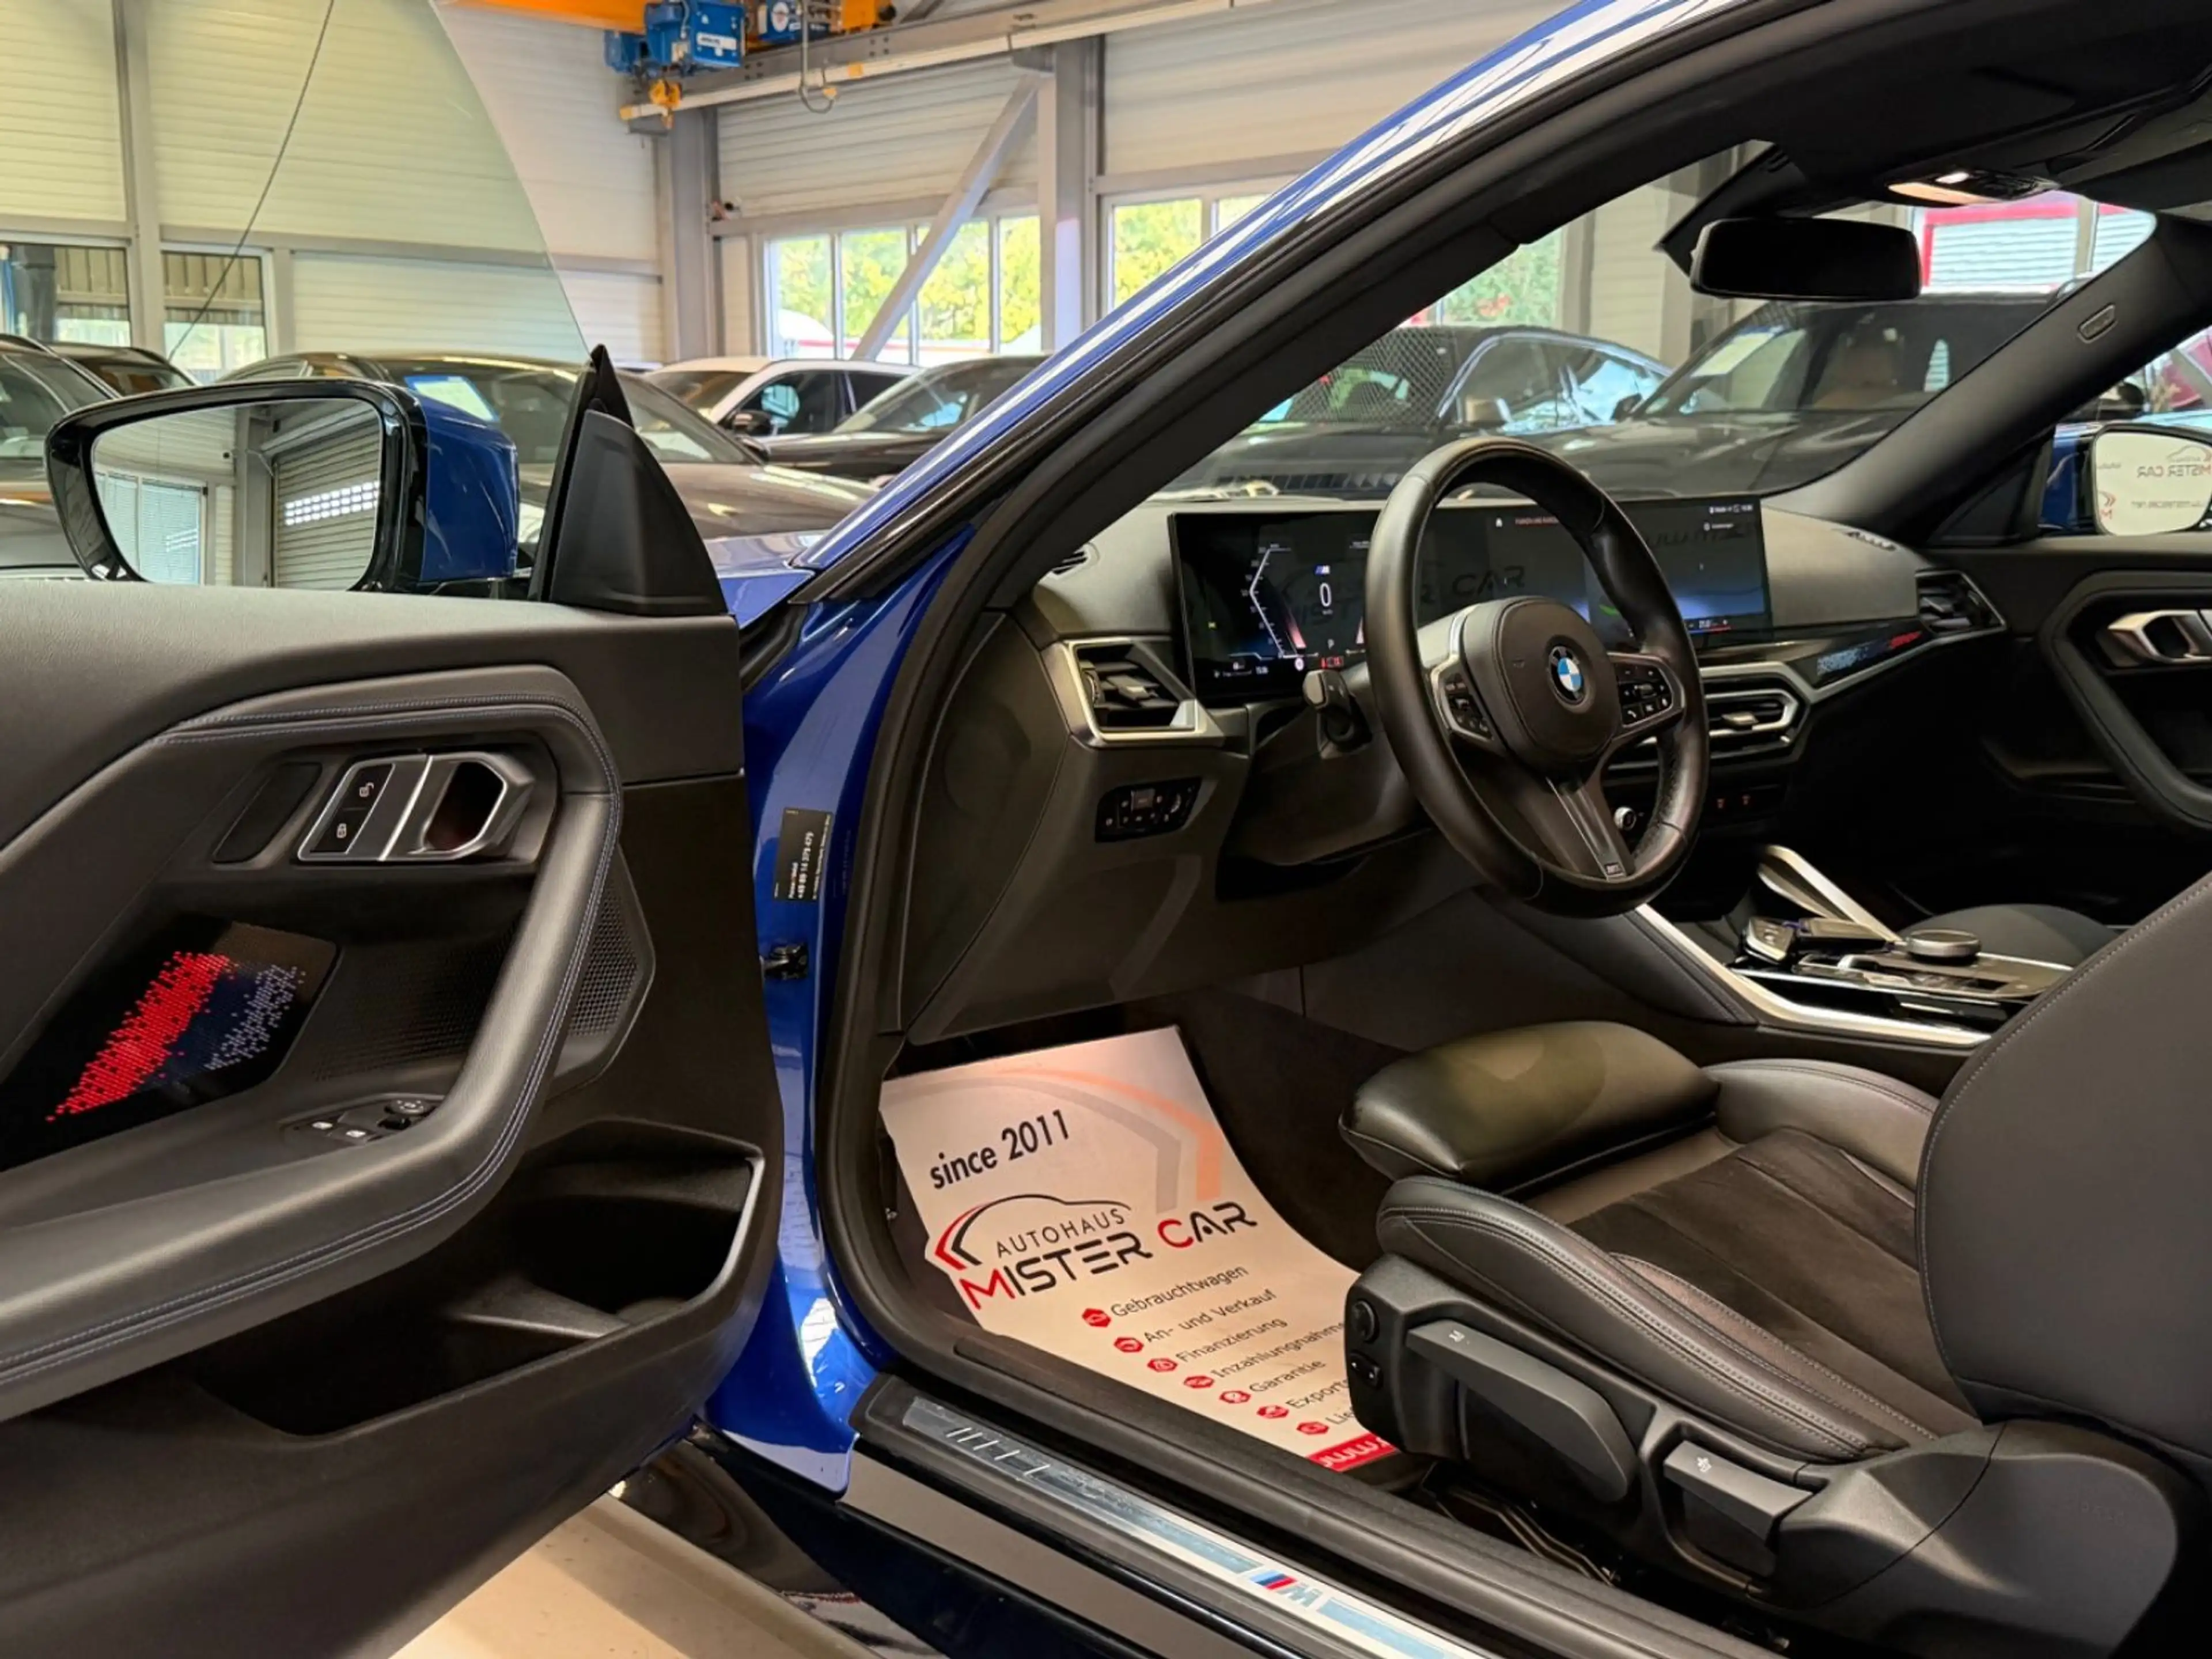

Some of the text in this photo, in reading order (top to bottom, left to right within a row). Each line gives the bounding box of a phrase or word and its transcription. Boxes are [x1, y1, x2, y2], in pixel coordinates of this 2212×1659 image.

[1319, 582, 1332, 607] 0
[930, 1109, 1069, 1190] since 2011
[959, 1201, 1258, 1310] MISTER CAR
[996, 1207, 1125, 1258] AUTOHAUS
[1111, 1266, 1250, 1317] Gebrauchtwagen
[1144, 1287, 1278, 1343] An- und Verkauf
[1175, 1317, 1289, 1363] Finanzierung
[1249, 1360, 1327, 1393] Garantie
